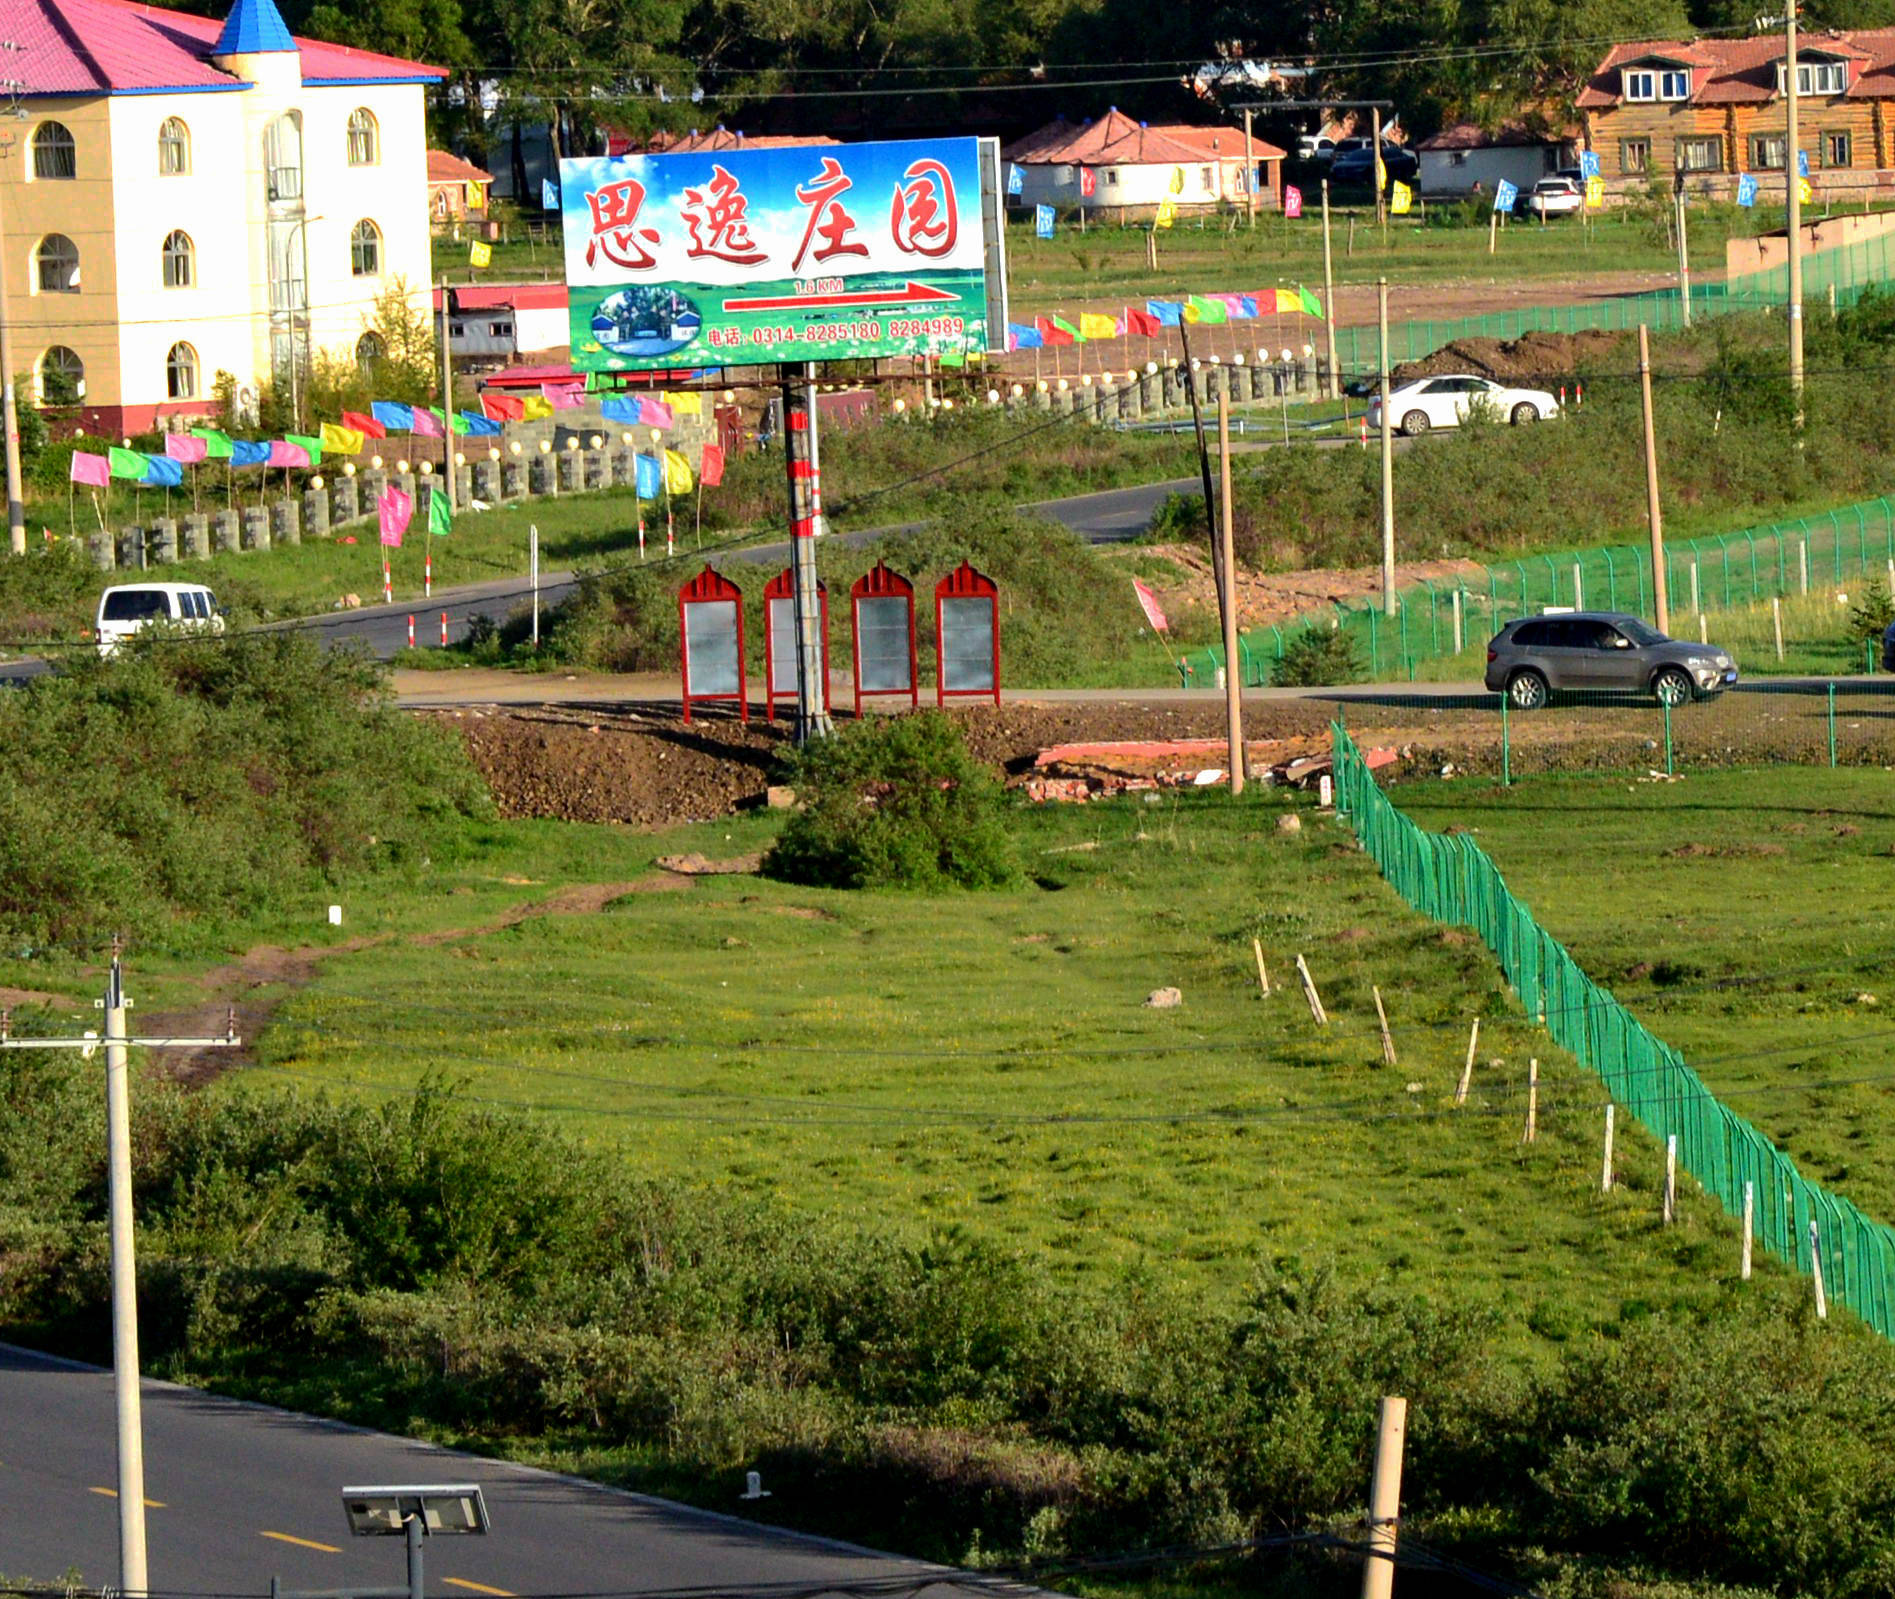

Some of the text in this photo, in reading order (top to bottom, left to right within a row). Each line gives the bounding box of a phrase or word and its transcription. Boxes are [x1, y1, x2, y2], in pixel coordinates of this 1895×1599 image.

[584, 156, 958, 274] 思逸庄园
[889, 317, 964, 339] 8284989
